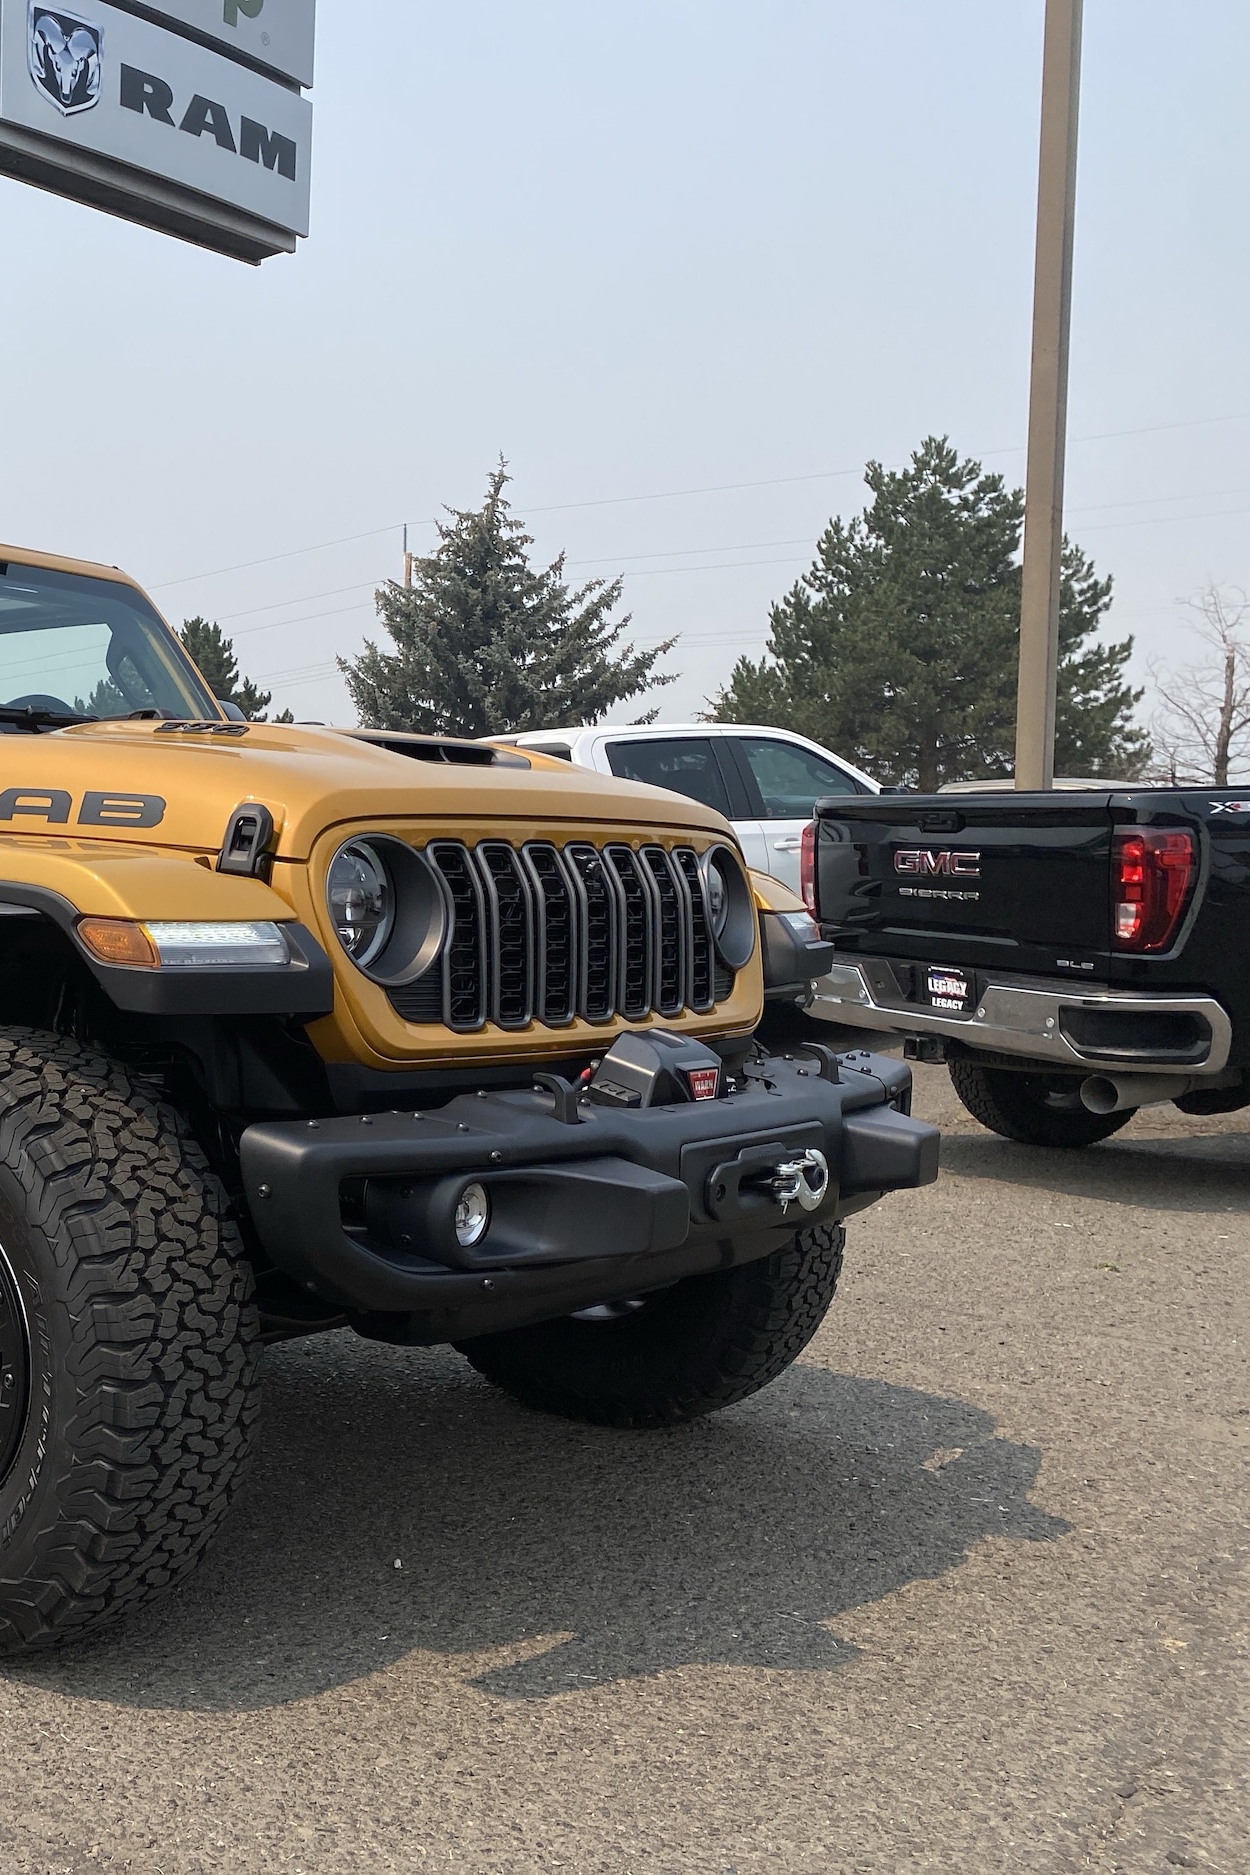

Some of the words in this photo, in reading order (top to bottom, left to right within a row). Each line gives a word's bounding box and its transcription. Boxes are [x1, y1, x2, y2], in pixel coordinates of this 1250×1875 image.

[119, 62, 297, 182] RAM
[894, 850, 982, 878] GMC
[898, 887, 980, 901] SIERRA
[927, 976, 967, 997] LEGACY
[931, 996, 964, 1011] LEGACY
[694, 1079, 714, 1091] WARN
